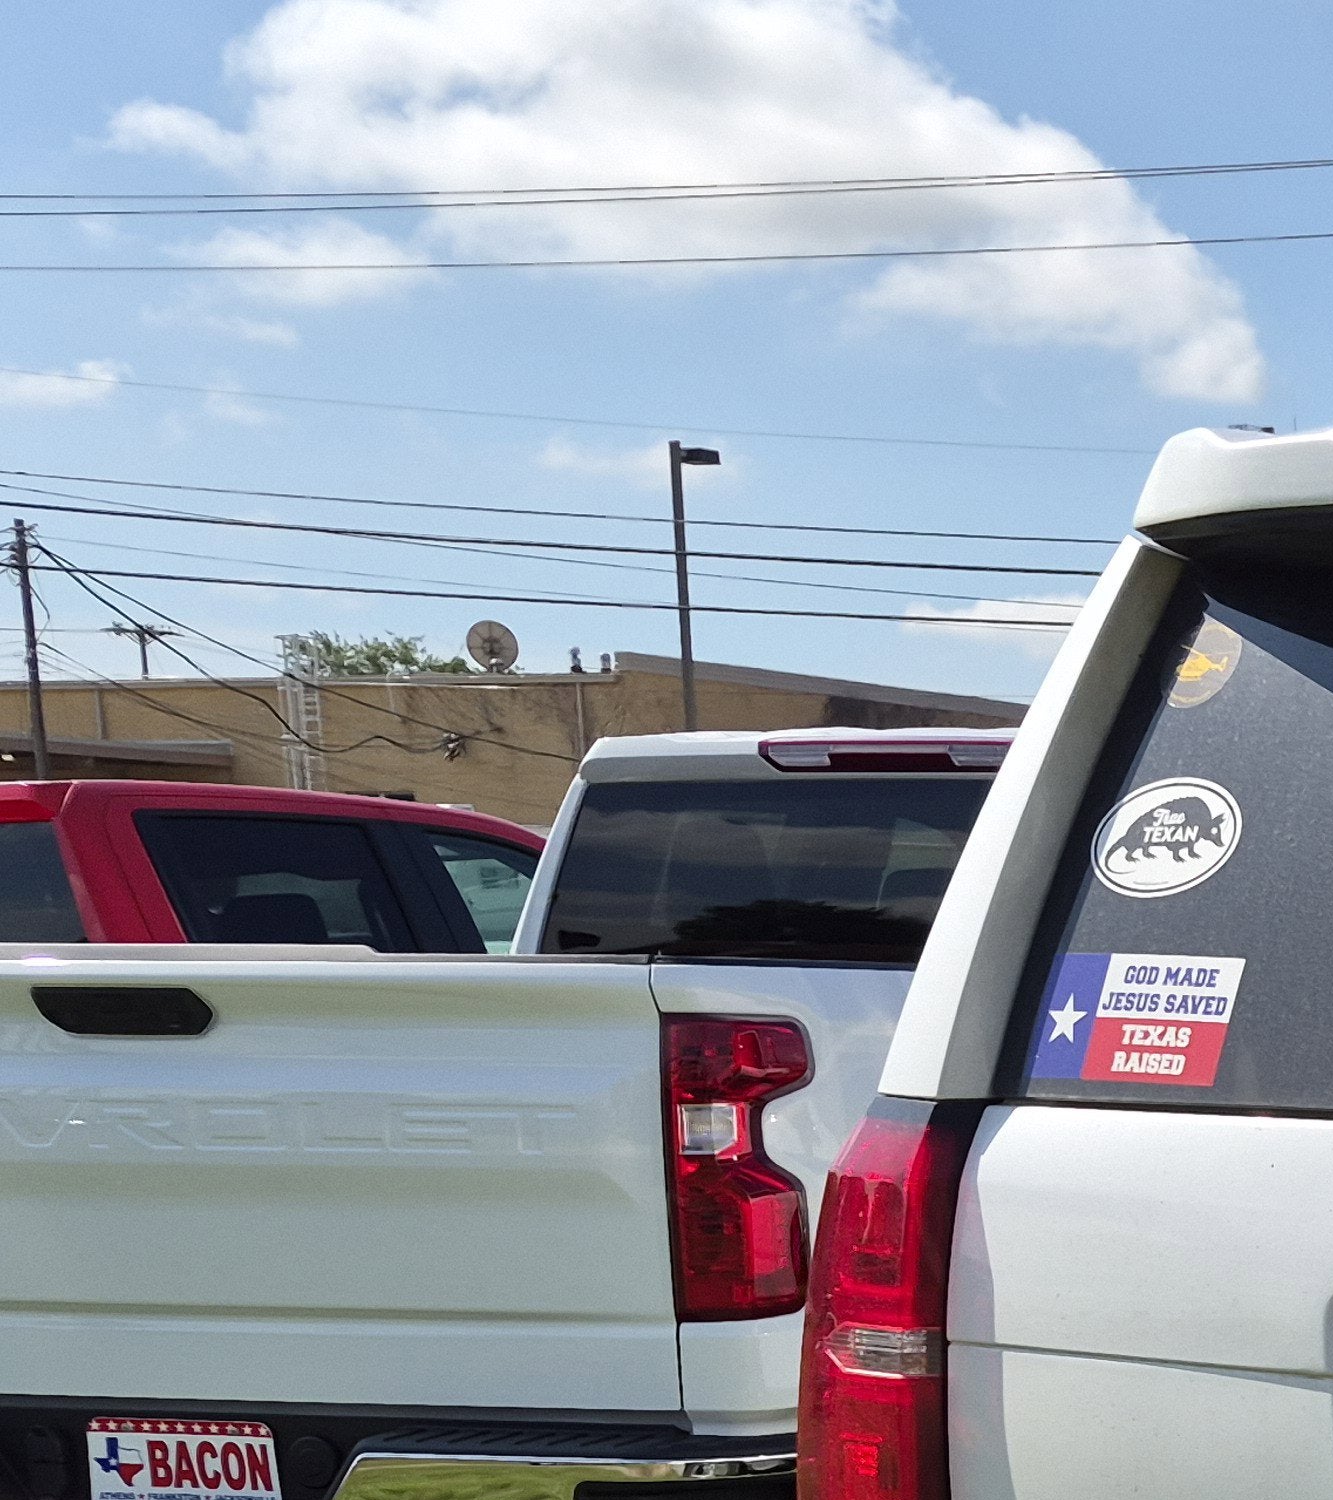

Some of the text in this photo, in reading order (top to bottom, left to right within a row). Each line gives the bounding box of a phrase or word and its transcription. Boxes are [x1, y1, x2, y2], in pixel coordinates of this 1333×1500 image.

[1143, 825, 1200, 843] TEXAN
[1124, 965, 1220, 988] GOD MADE
[1102, 991, 1228, 1016] JESUS SAVED
[1121, 1024, 1192, 1048] TEXAS
[1110, 1050, 1187, 1076] RAISED
[146, 1439, 275, 1492] BACON
[99, 1491, 136, 1500] ATHENS
